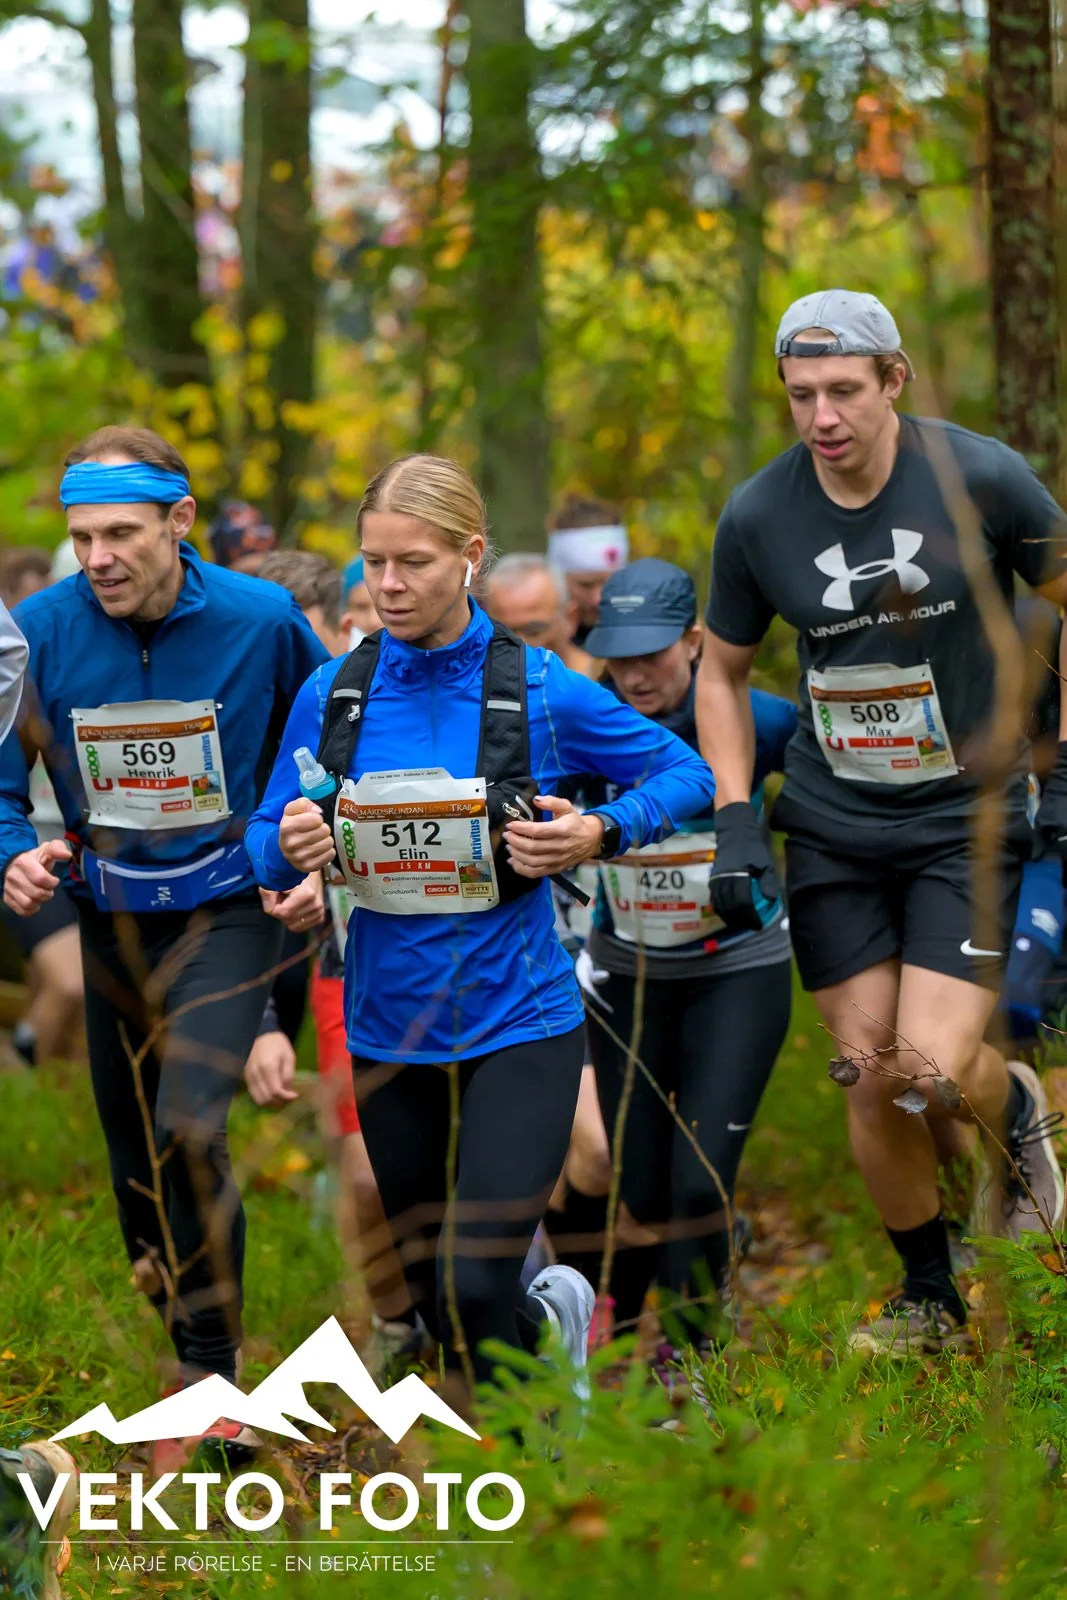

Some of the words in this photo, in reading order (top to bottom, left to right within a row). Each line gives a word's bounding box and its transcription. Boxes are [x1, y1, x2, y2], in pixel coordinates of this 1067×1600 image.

[809, 615, 873, 637] UNDER
[850, 702, 900, 723] 508
[866, 725, 893, 737] Max
[122, 741, 176, 766] 569
[127, 767, 176, 779] Henrik
[341, 821, 356, 859] coop
[381, 821, 442, 847] 512
[470, 818, 483, 860] Aktivitus
[399, 848, 429, 860] Elin
[400, 862, 411, 870] 15
[417, 862, 431, 870] KM
[638, 870, 685, 890] 420
